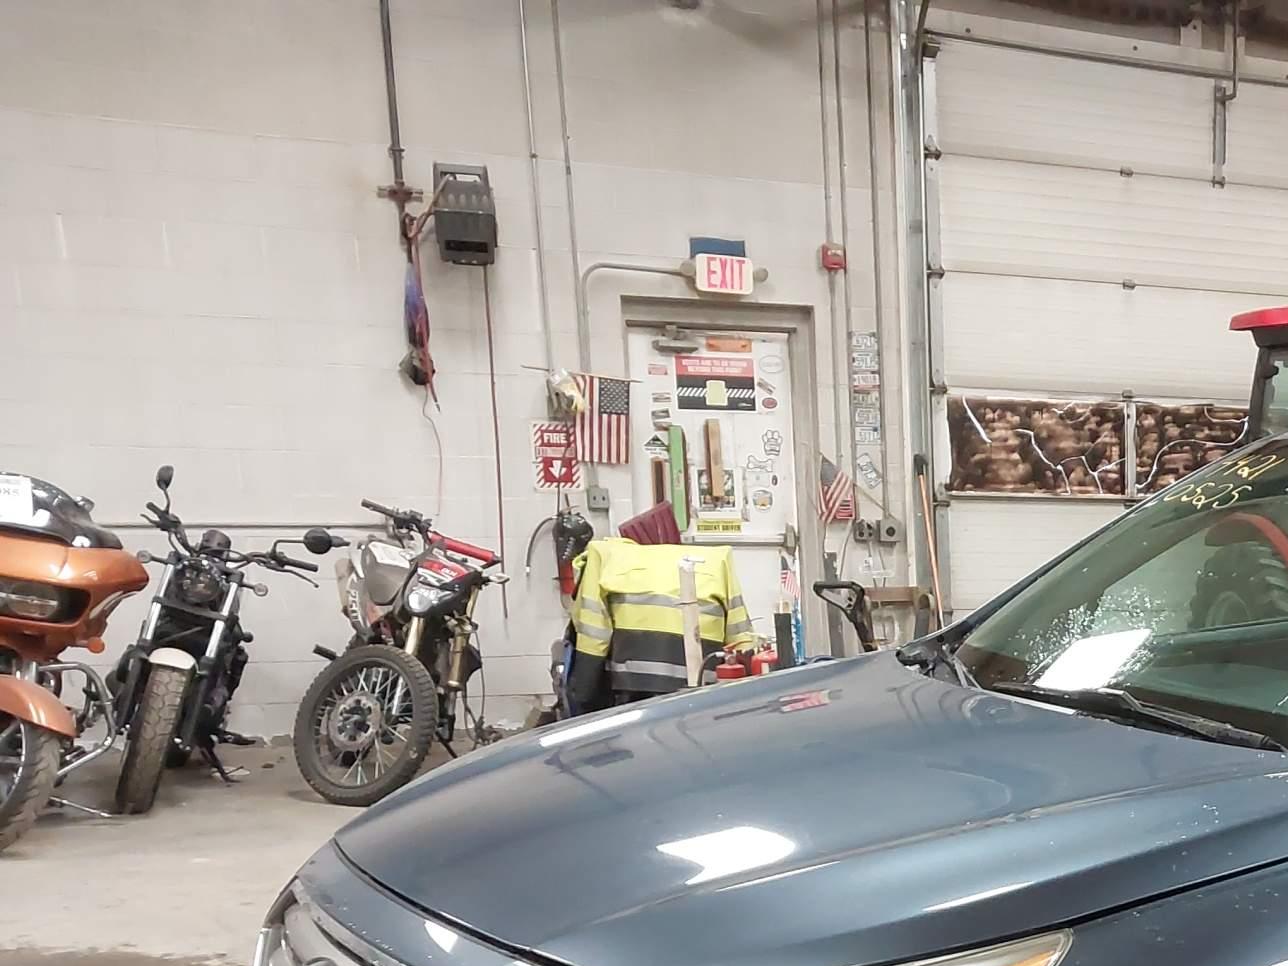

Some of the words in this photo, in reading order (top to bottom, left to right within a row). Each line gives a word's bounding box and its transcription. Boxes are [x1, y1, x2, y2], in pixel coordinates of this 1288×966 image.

[706, 256, 745, 290] EXIT
[543, 432, 568, 444] FIRE
[1163, 482, 1252, 509] 0525
